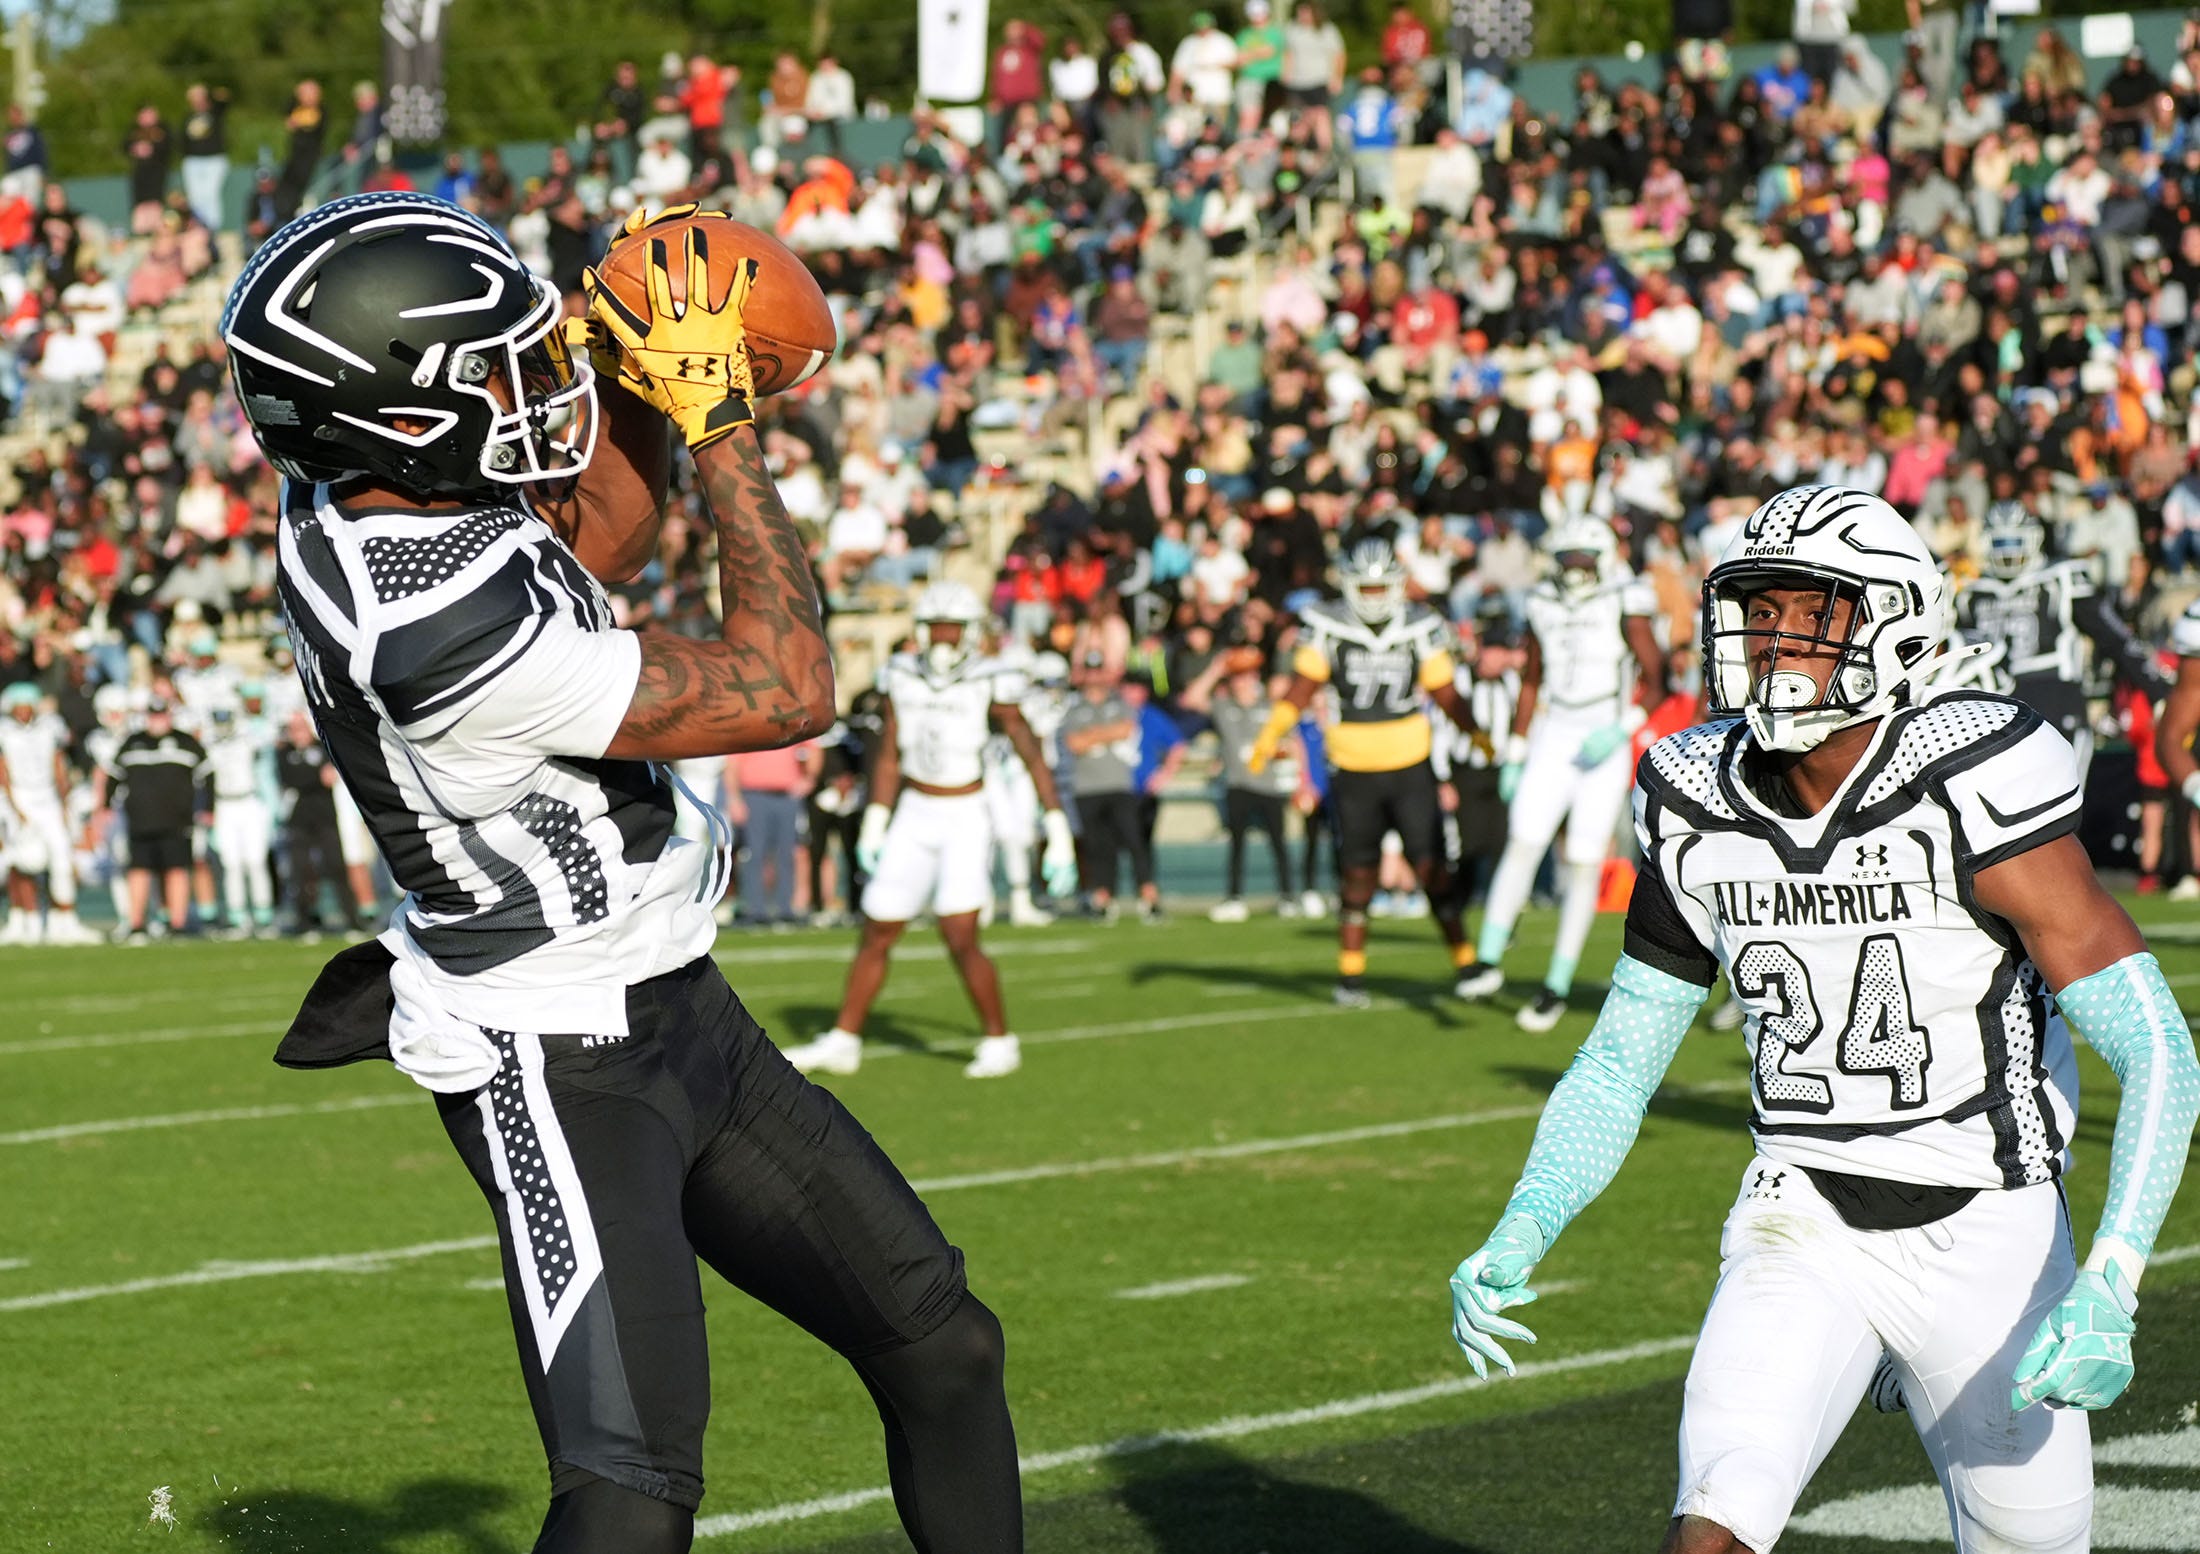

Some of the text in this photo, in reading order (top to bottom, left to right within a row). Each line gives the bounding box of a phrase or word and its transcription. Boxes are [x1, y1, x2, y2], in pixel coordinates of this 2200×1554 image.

[1744, 545, 1795, 556] Riddell
[1344, 666, 1411, 710] 77
[1714, 881, 1912, 926] ALL AMERICA
[1731, 933, 1933, 1115] 24
